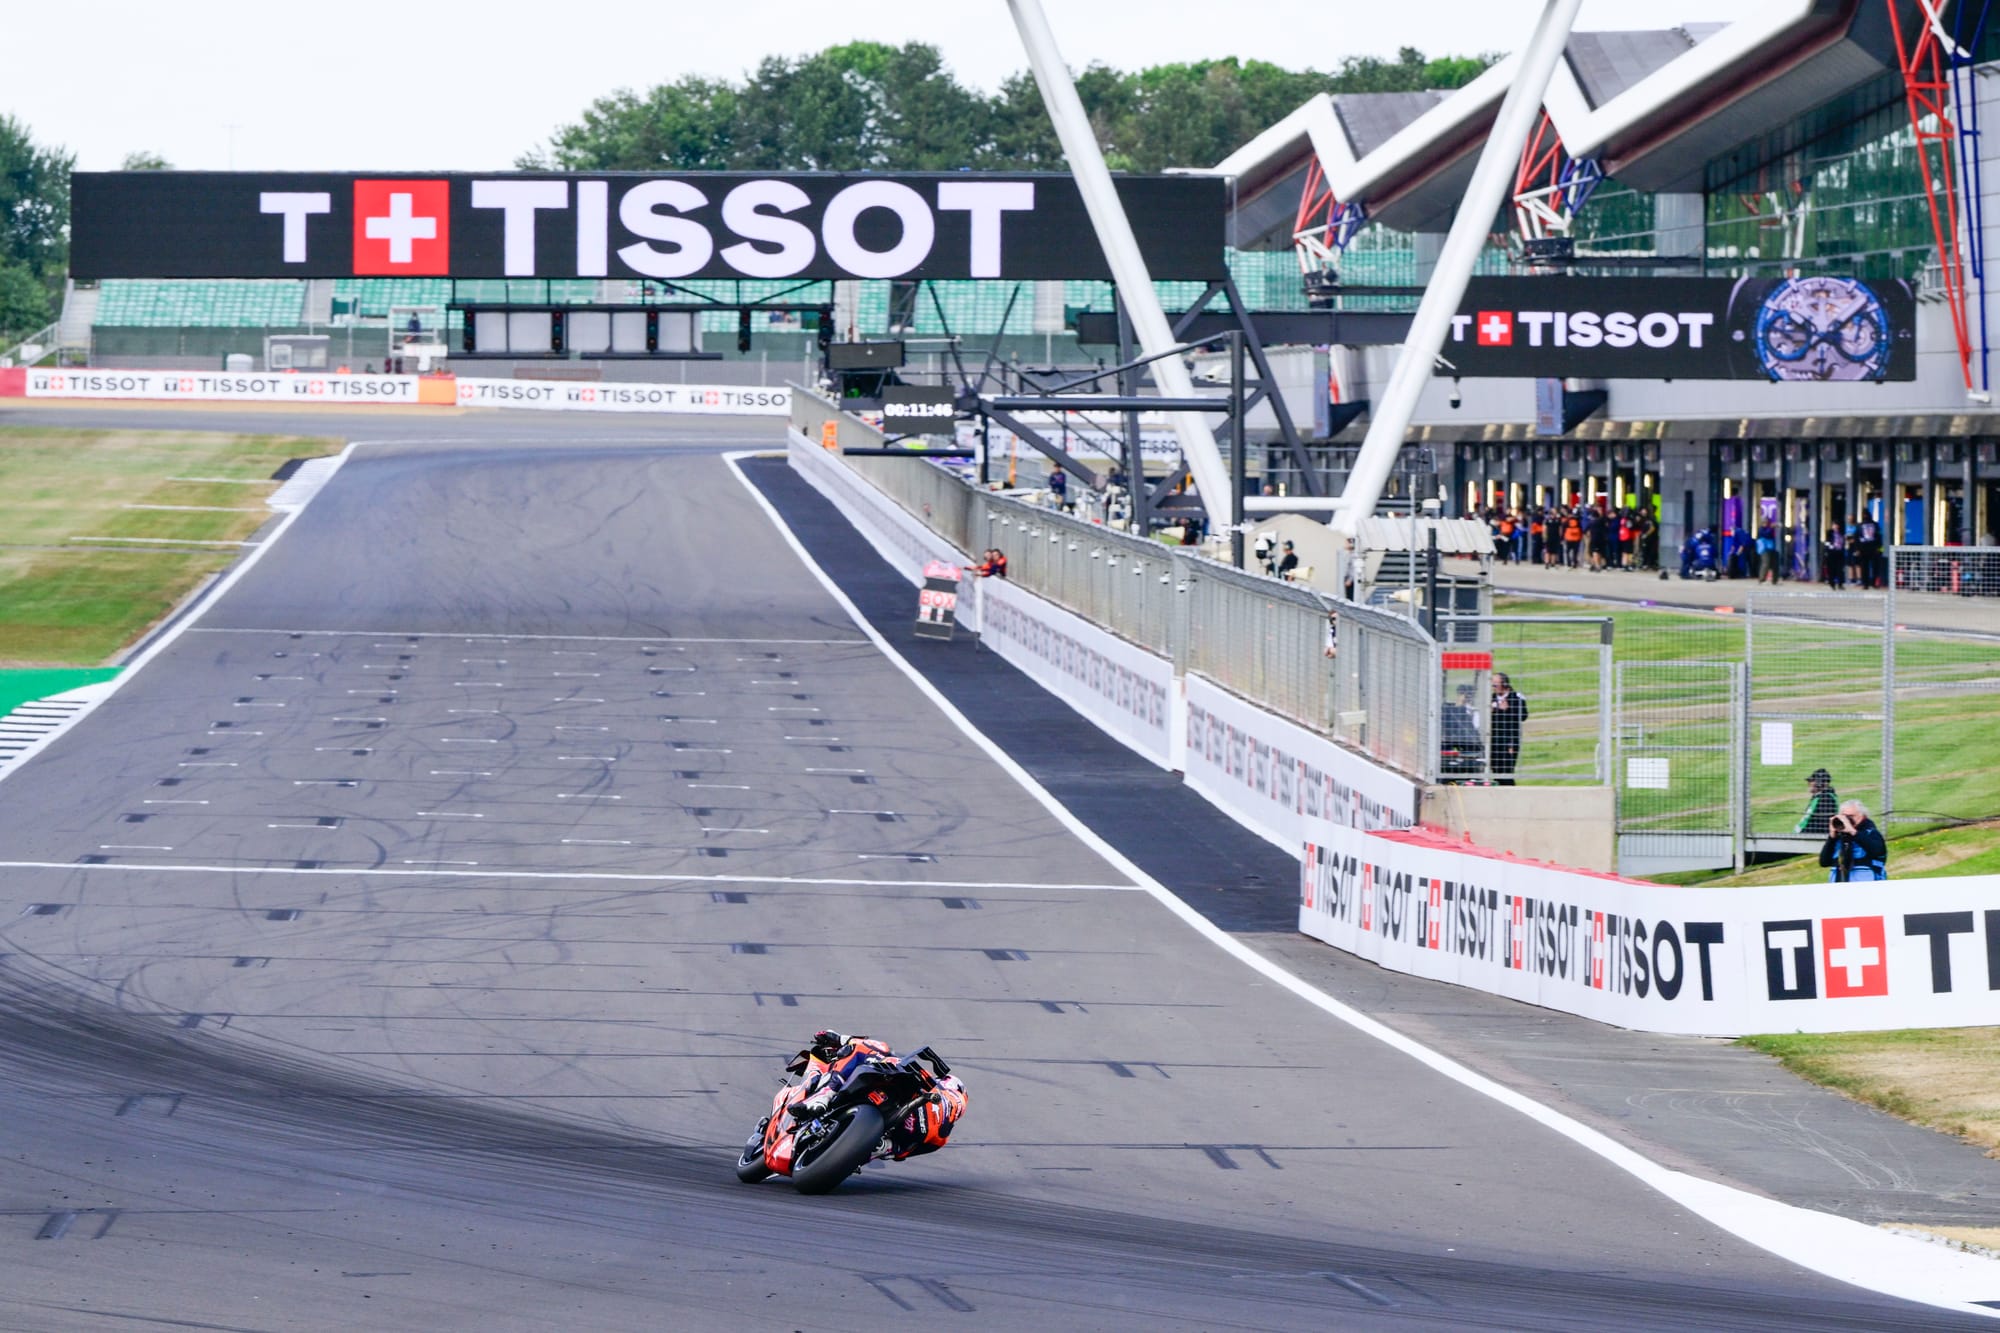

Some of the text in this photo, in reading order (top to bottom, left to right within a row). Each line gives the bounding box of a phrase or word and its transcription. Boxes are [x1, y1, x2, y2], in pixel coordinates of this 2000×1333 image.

[471, 178, 1035, 279] TISSOT
[1518, 311, 1713, 348] TISSOT
[69, 376, 411, 396] TISSOT TISSOT TISSOT
[478, 385, 792, 407] TISSOT TISSOT TISSO
[1374, 864, 1412, 944] TSOT
[1444, 880, 1498, 962] TISSOT
[1525, 897, 1578, 981] TISSOT
[1607, 913, 1725, 1001] TISSOT
